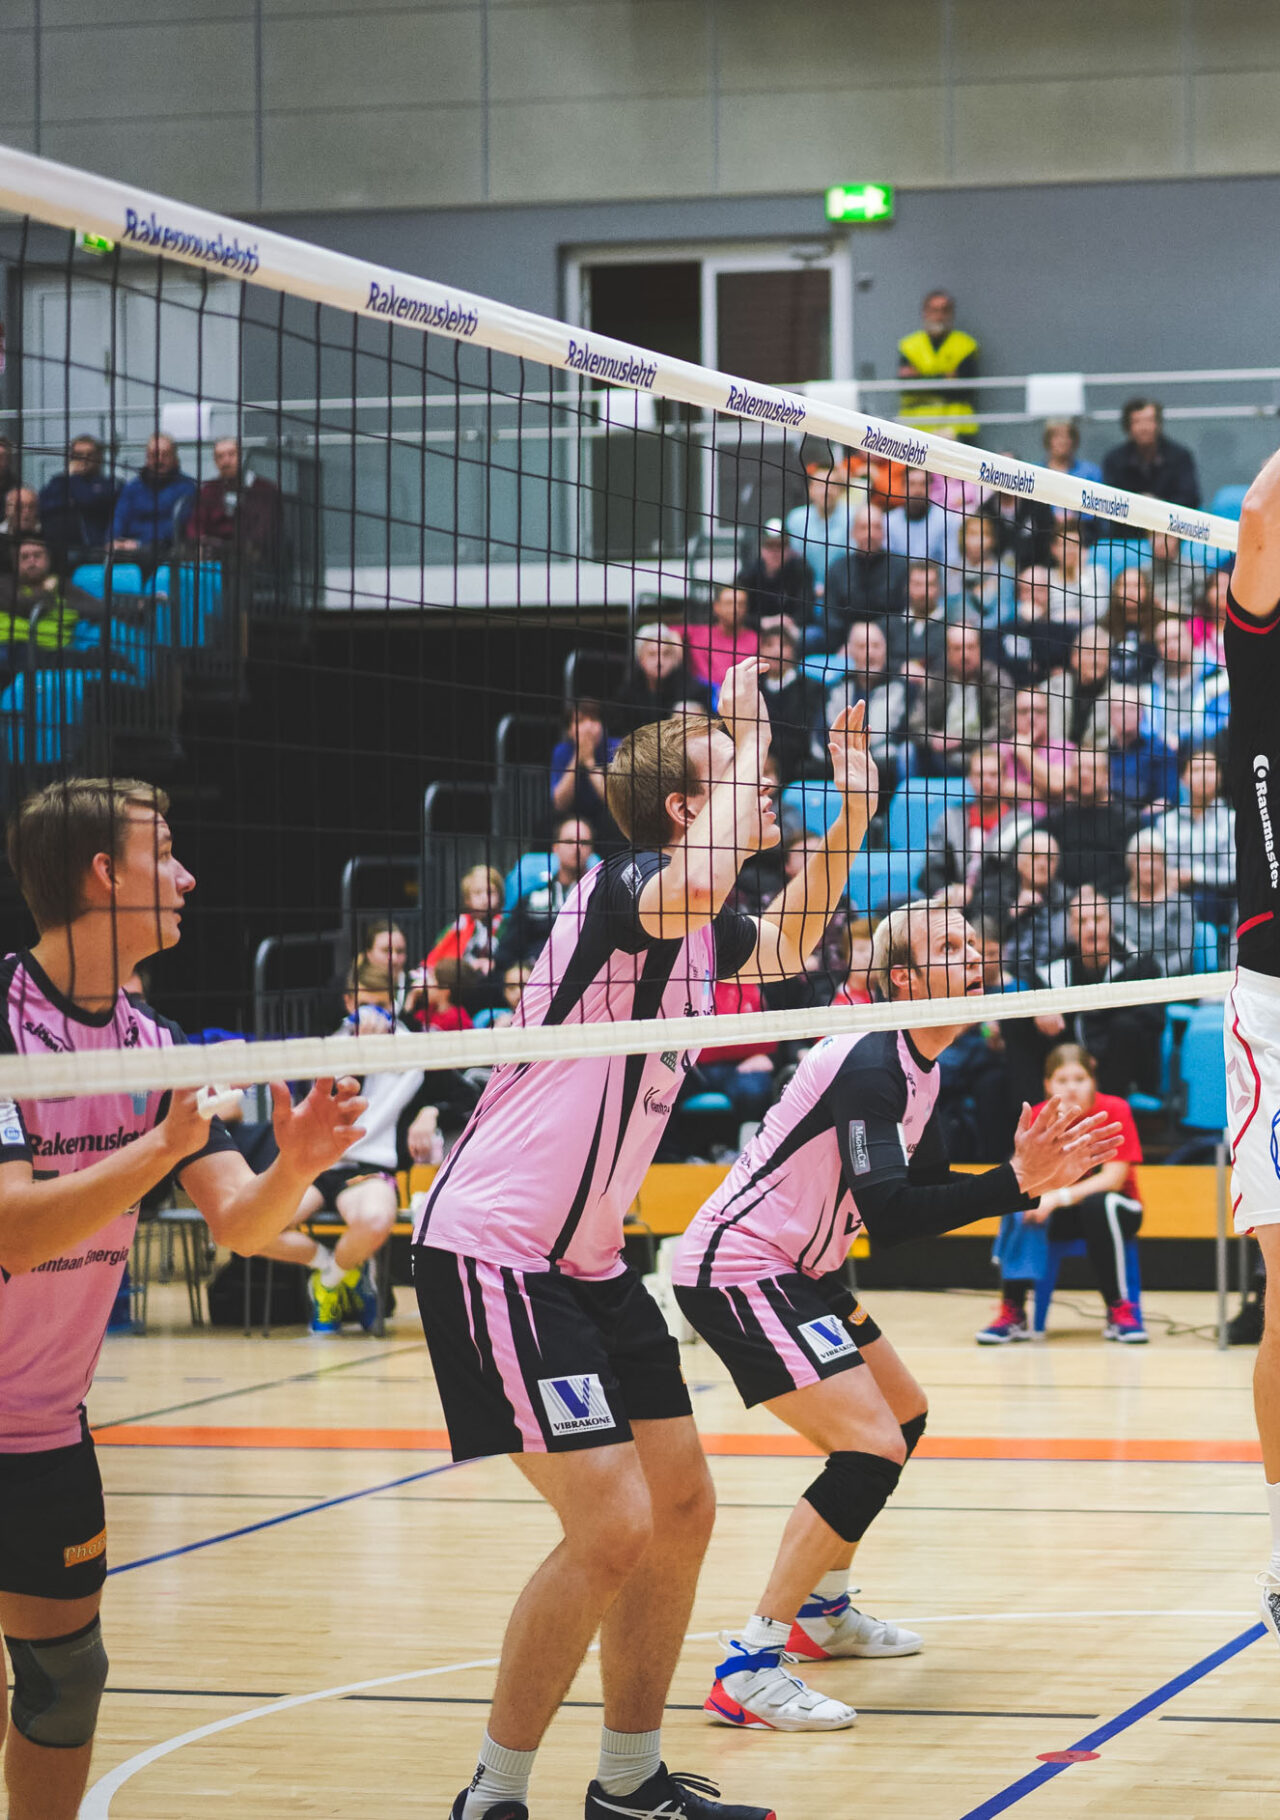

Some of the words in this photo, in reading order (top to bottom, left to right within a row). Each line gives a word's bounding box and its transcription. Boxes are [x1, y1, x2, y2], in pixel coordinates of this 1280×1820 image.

[122, 207, 260, 276] Rakennuslehti
[365, 281, 479, 336] Rakennuslehti
[564, 340, 658, 388] Rakennuslehti
[726, 385, 807, 427] Rakennuslehti
[860, 425, 930, 466] Rakennuslehti
[978, 461, 1036, 495] Rakennuslehti
[1081, 489, 1130, 518] Rakennuslehti
[1255, 780, 1280, 889] Raumaster
[553, 1416, 612, 1431] VIBRAKONE
